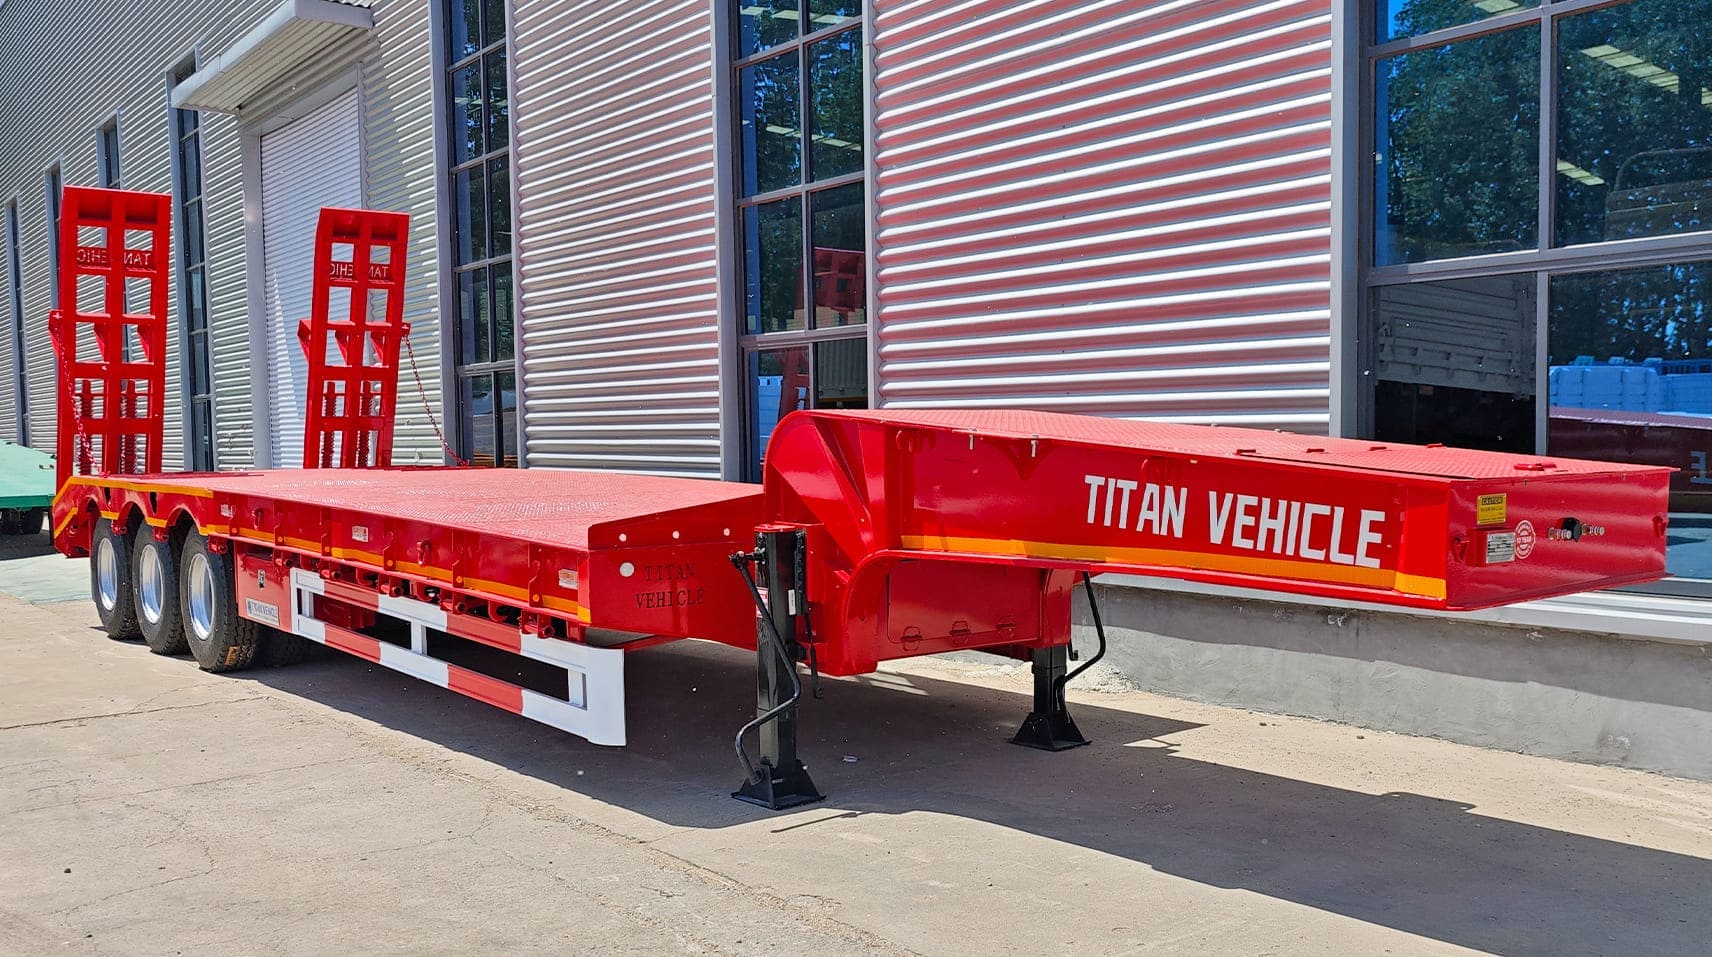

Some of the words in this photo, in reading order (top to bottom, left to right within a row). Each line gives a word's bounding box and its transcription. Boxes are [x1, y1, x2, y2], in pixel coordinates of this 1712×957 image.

[1084, 475, 1188, 539] TITAN
[1208, 490, 1386, 569] VEHICLE
[644, 562, 695, 581] TITAN
[634, 588, 705, 609] VEHICLE
